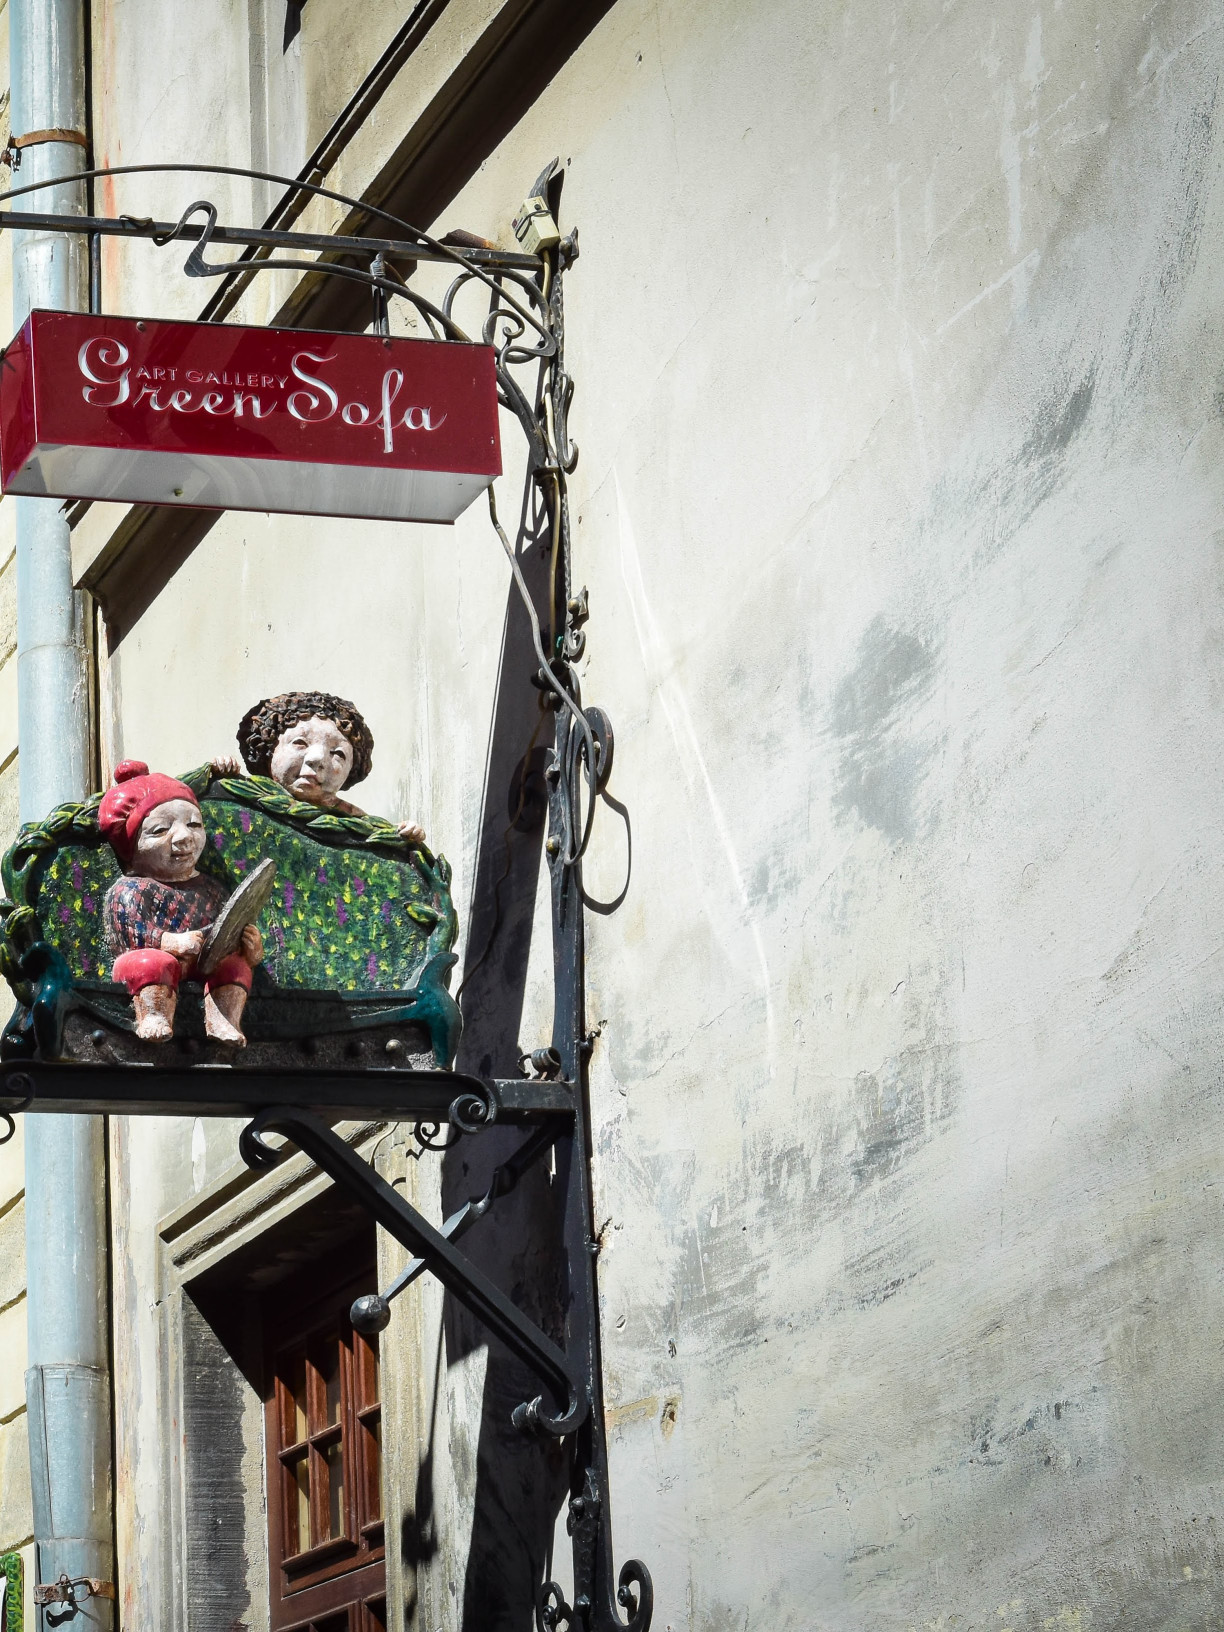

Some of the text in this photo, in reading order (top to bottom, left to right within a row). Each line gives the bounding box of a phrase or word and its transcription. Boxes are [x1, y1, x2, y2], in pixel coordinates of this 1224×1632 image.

[78, 336, 447, 454] Green Sofa
[135, 365, 288, 389] ART GALLERY
